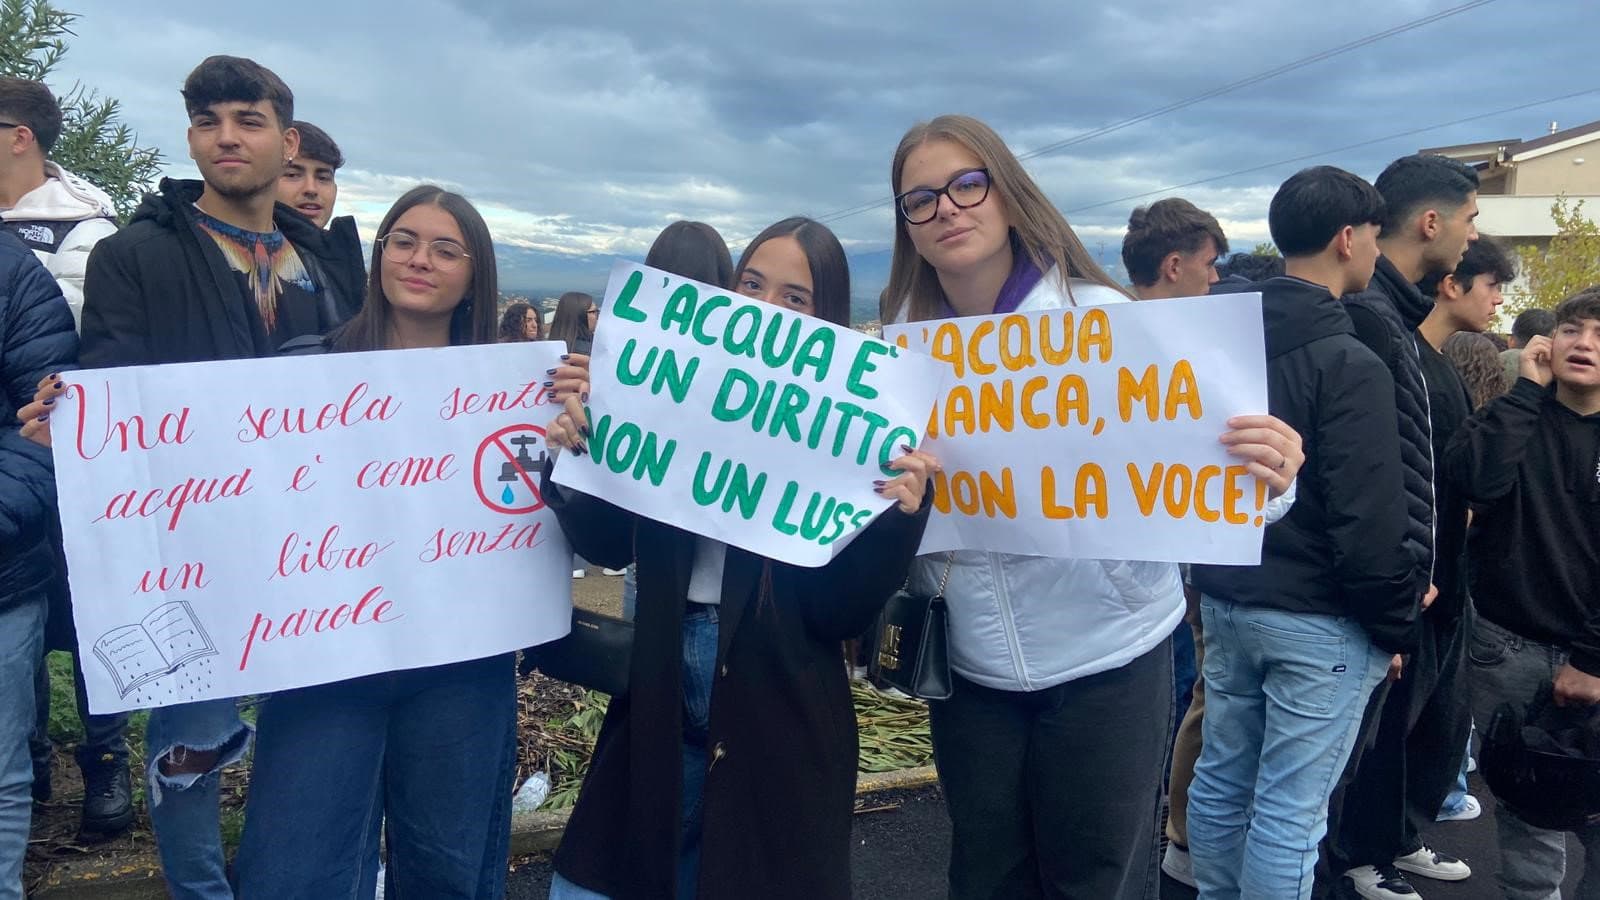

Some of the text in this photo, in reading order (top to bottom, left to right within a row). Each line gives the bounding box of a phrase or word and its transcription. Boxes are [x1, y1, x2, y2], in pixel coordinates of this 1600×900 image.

[612, 270, 836, 383] L'ACQUA
[896, 308, 1113, 378] 'ACQUA
[65, 380, 195, 460] Una
[237, 382, 402, 443] scuola
[615, 338, 917, 478] UN DIRITTO
[1118, 359, 1203, 422] MA
[91, 468, 253, 531] acqua
[356, 453, 459, 489] come
[584, 406, 677, 487] NON
[692, 451, 768, 520] UN
[1040, 462, 1109, 520] LA
[1126, 462, 1266, 527] VOCE!
[132, 521, 546, 595] un libro senza
[239, 585, 406, 671] parole
